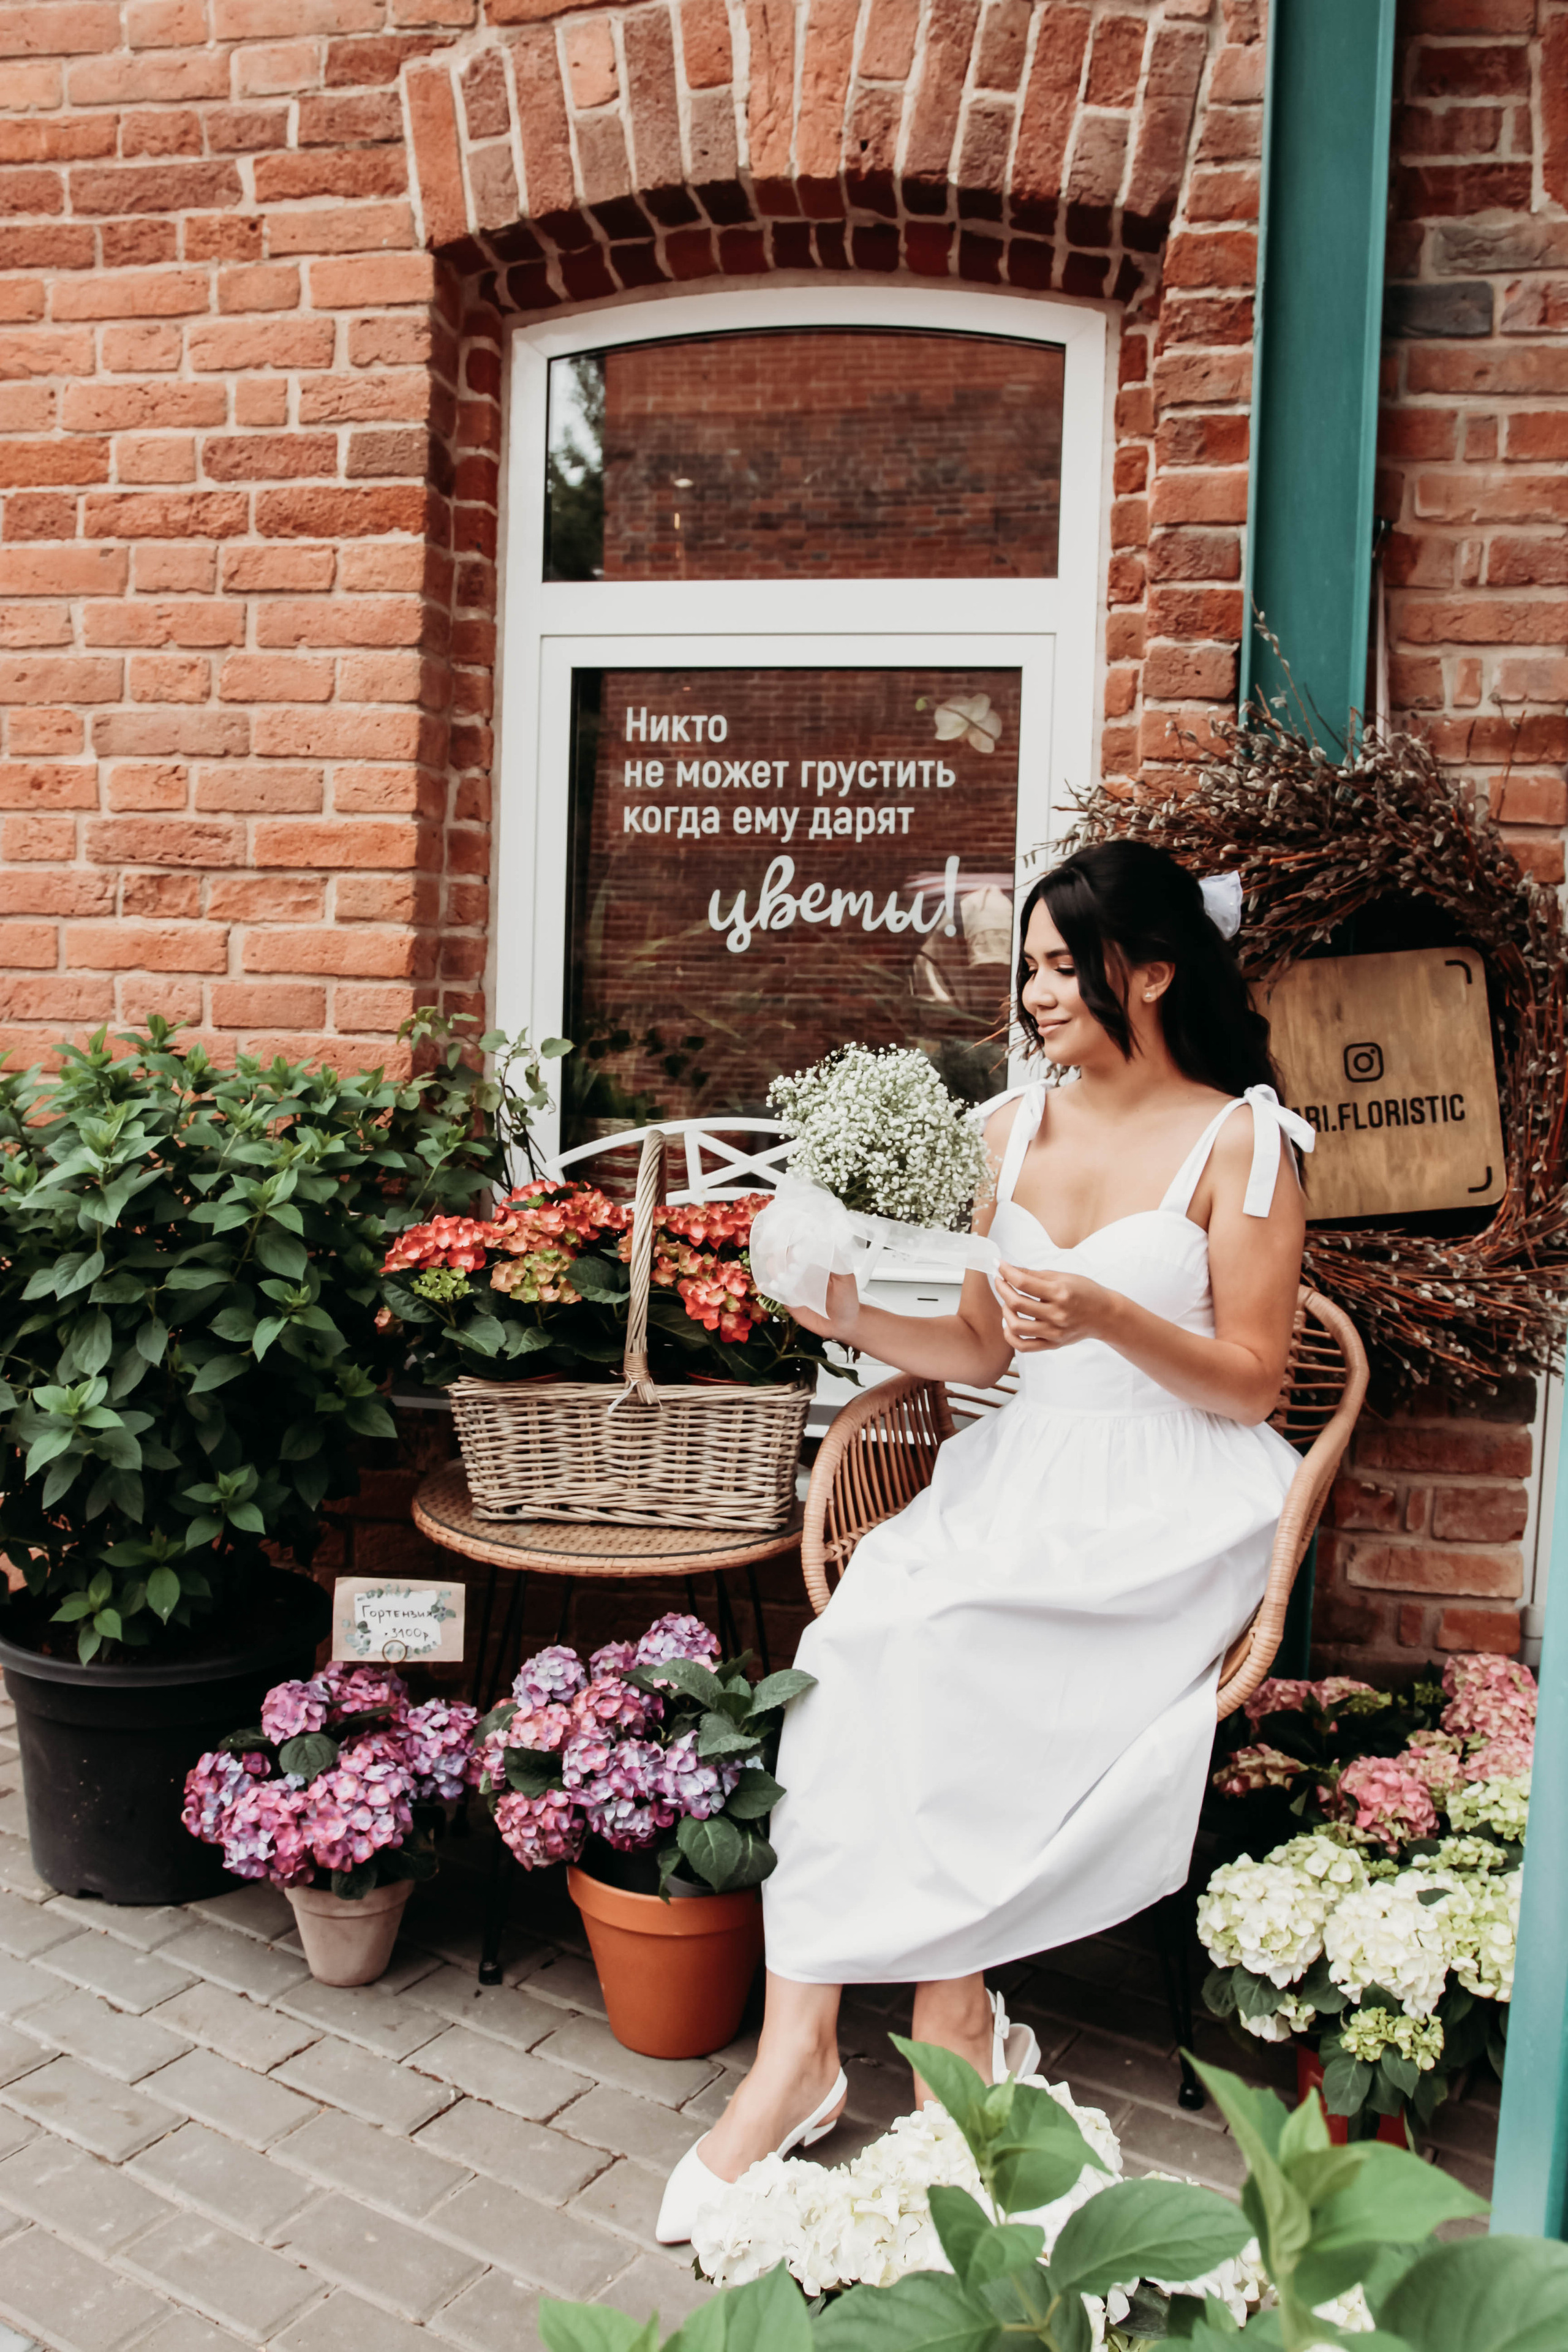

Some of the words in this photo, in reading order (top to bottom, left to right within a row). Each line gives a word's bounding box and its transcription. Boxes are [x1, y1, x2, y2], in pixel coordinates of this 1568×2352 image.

[625, 706, 728, 743] Никто
[624, 760, 665, 788] не
[676, 760, 790, 788] может
[801, 760, 956, 797] грустить
[623, 805, 721, 839] когда
[733, 806, 801, 843] ему
[808, 806, 915, 843] дарят
[708, 854, 960, 953] цветы!
[1292, 1093, 1466, 1133] RI.FLORISTIC
